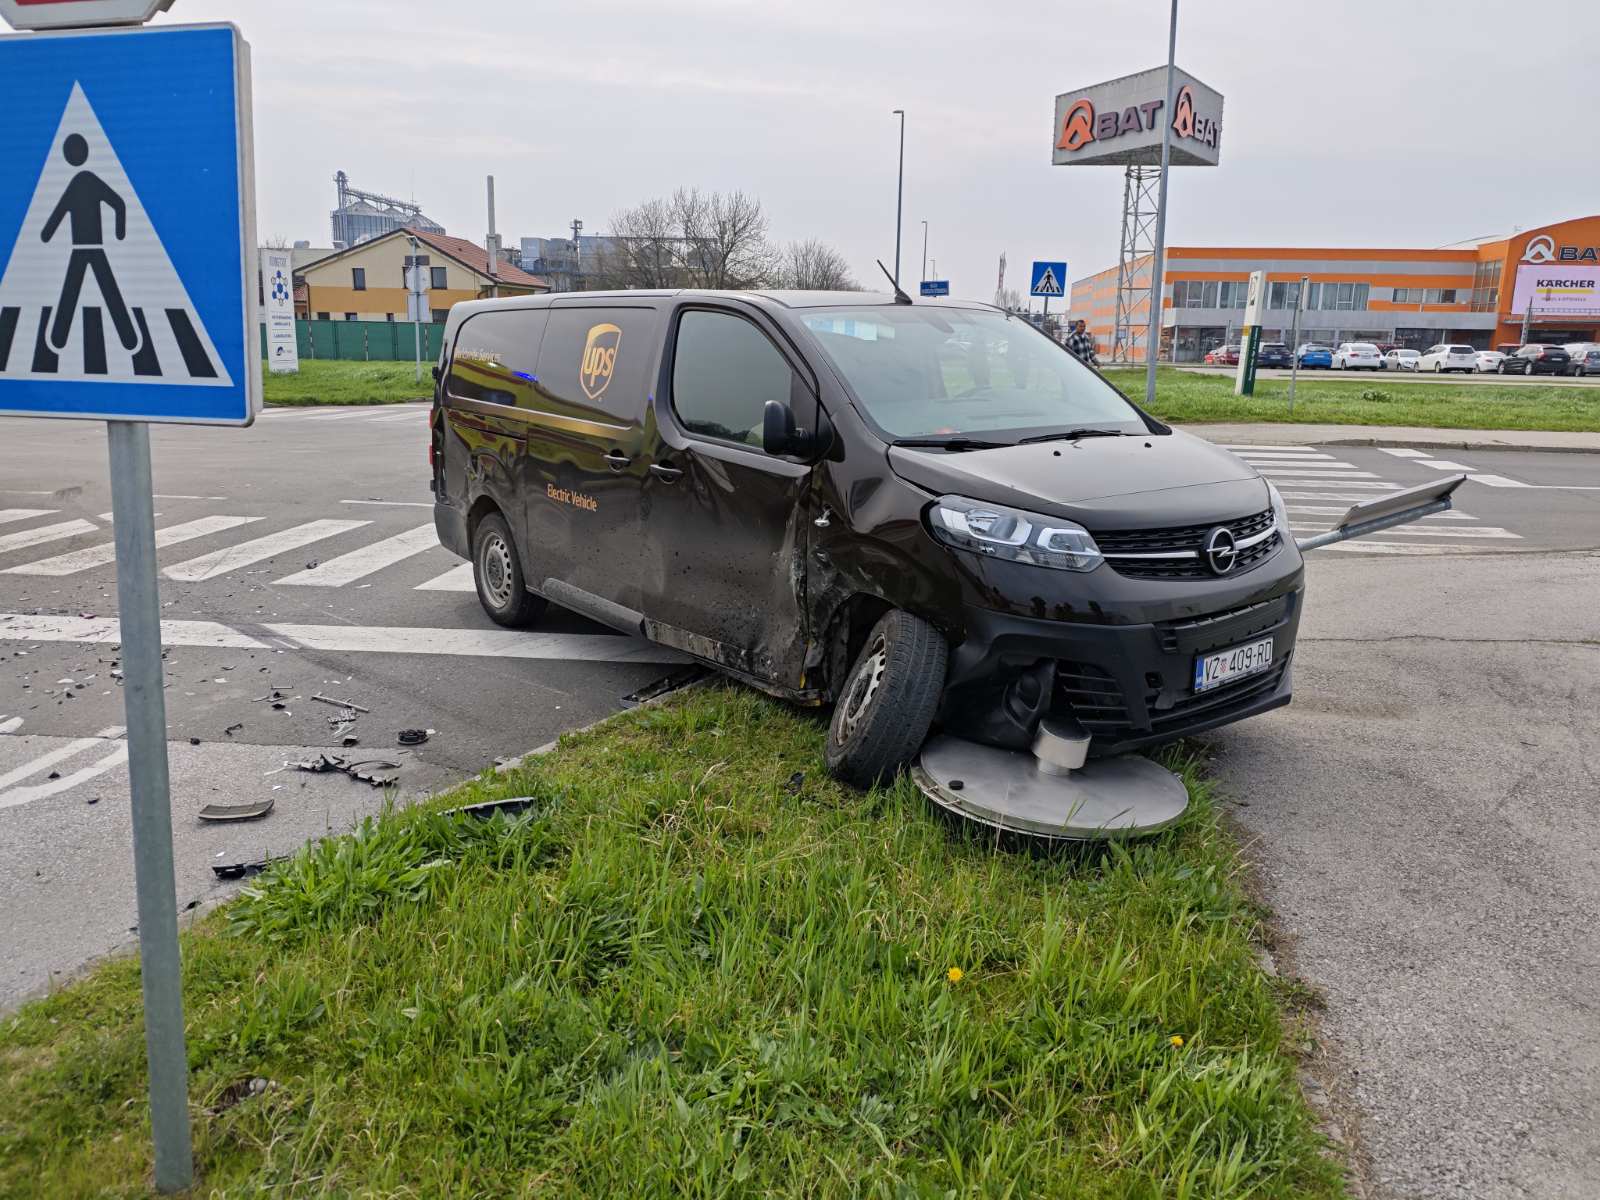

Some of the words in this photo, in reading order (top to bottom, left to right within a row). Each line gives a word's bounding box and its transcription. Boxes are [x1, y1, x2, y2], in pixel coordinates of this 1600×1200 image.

[1096, 100, 1164, 141] BAT
[1560, 247, 1600, 261] BA
[584, 347, 615, 387] ups
[547, 483, 571, 504] Electric
[571, 490, 598, 512] Vehicle
[1205, 656, 1221, 681] VZ
